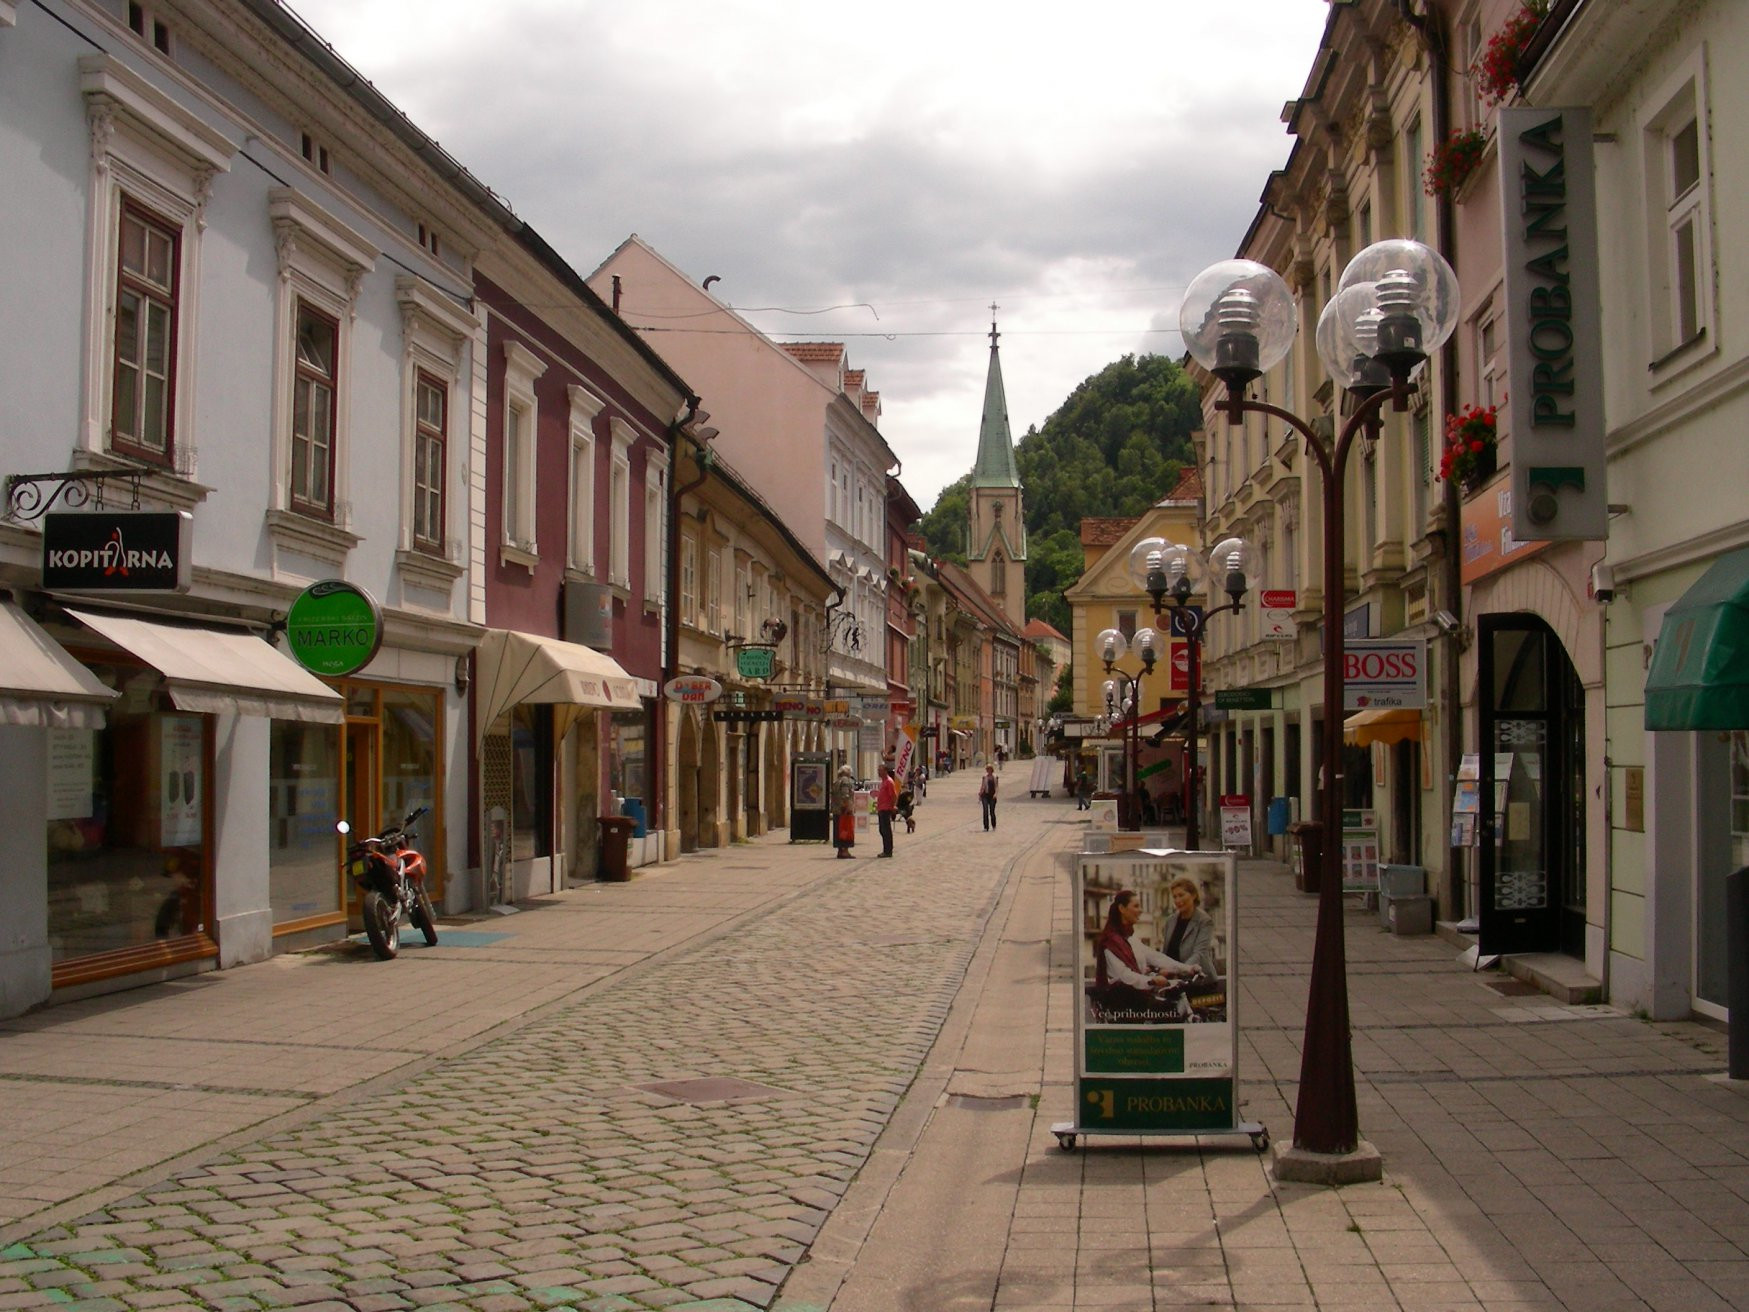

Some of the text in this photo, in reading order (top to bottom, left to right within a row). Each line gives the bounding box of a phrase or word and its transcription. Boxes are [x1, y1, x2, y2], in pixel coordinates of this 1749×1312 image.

[1519, 113, 1576, 429] PROBANKA
[49, 537, 173, 572] KOPITARNA
[297, 628, 369, 647] MARKO
[1344, 652, 1417, 680] BOSS
[1374, 696, 1402, 706] trafika
[896, 740, 912, 777] RENO
[1126, 1095, 1226, 1112] PROBANKA
